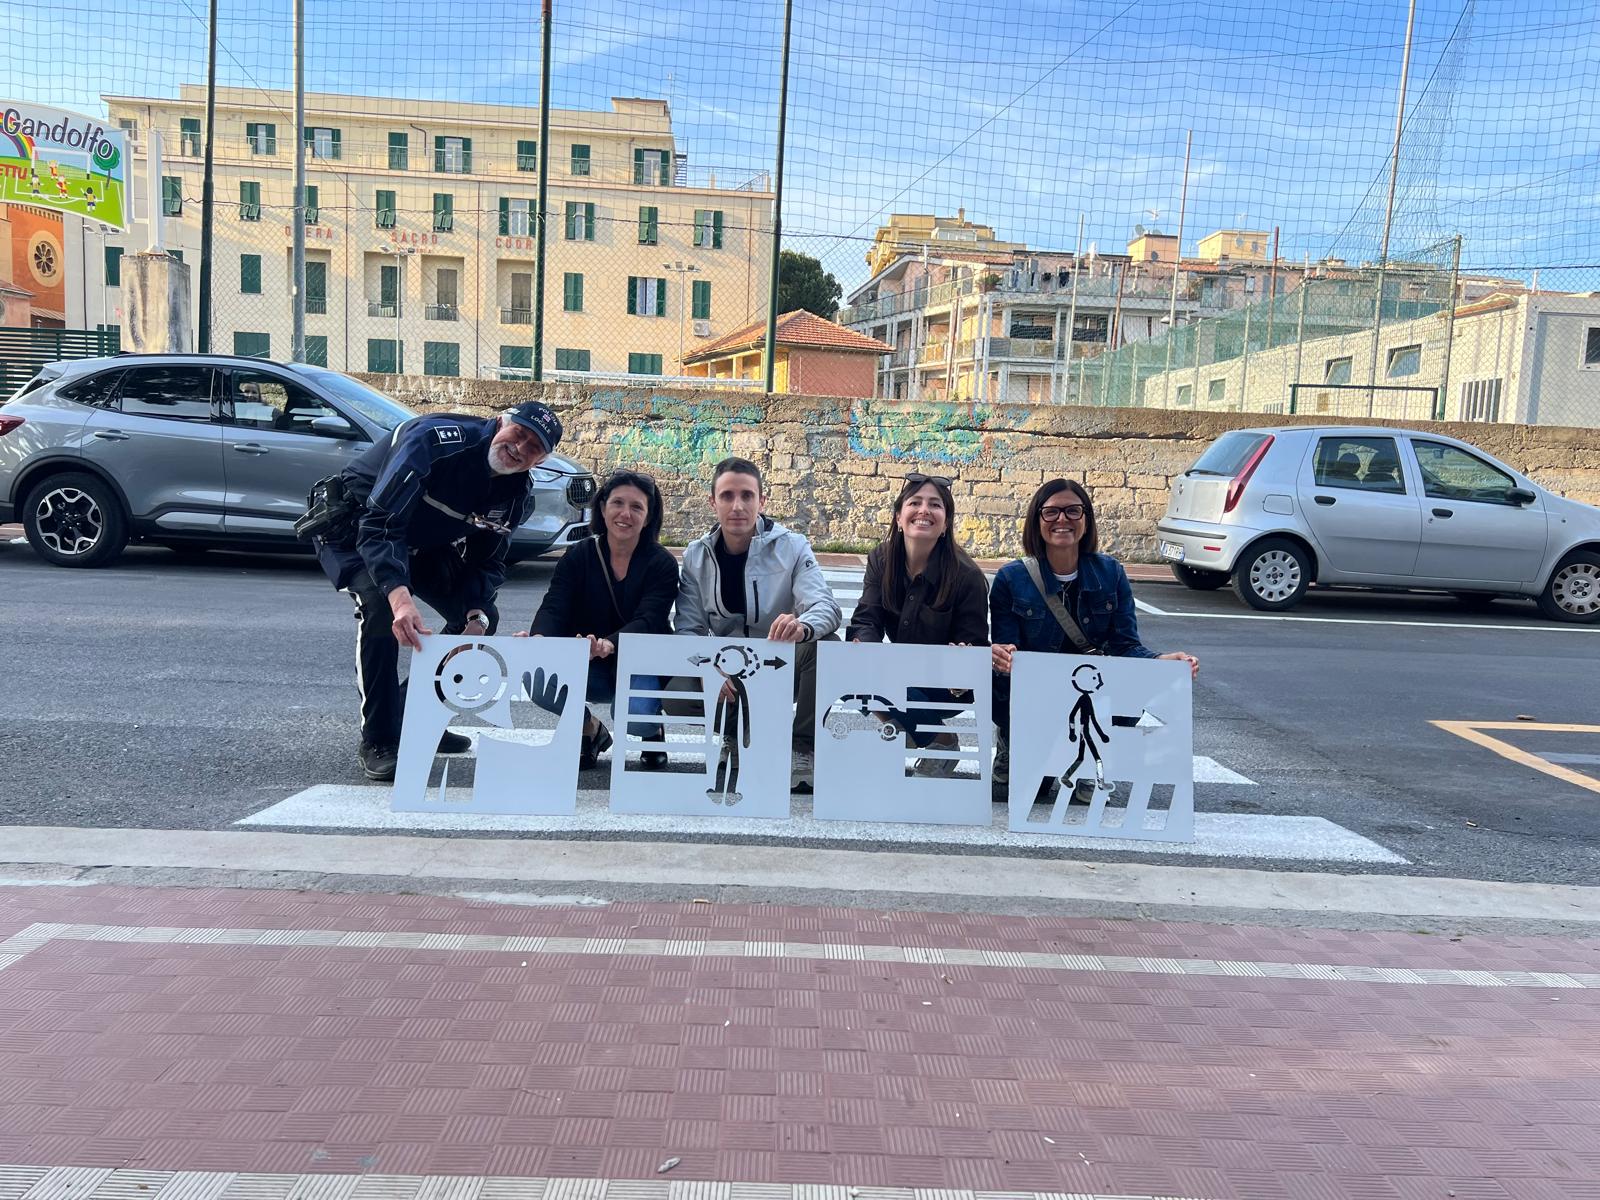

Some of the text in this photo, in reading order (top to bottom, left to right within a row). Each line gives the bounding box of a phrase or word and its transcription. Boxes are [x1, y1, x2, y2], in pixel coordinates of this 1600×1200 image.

[4, 108, 113, 158] Gandolfo
[285, 226, 532, 250] OERA SACRO CUOR
[530, 415, 551, 433] LOCALE
[538, 407, 558, 426] POLIZIA
